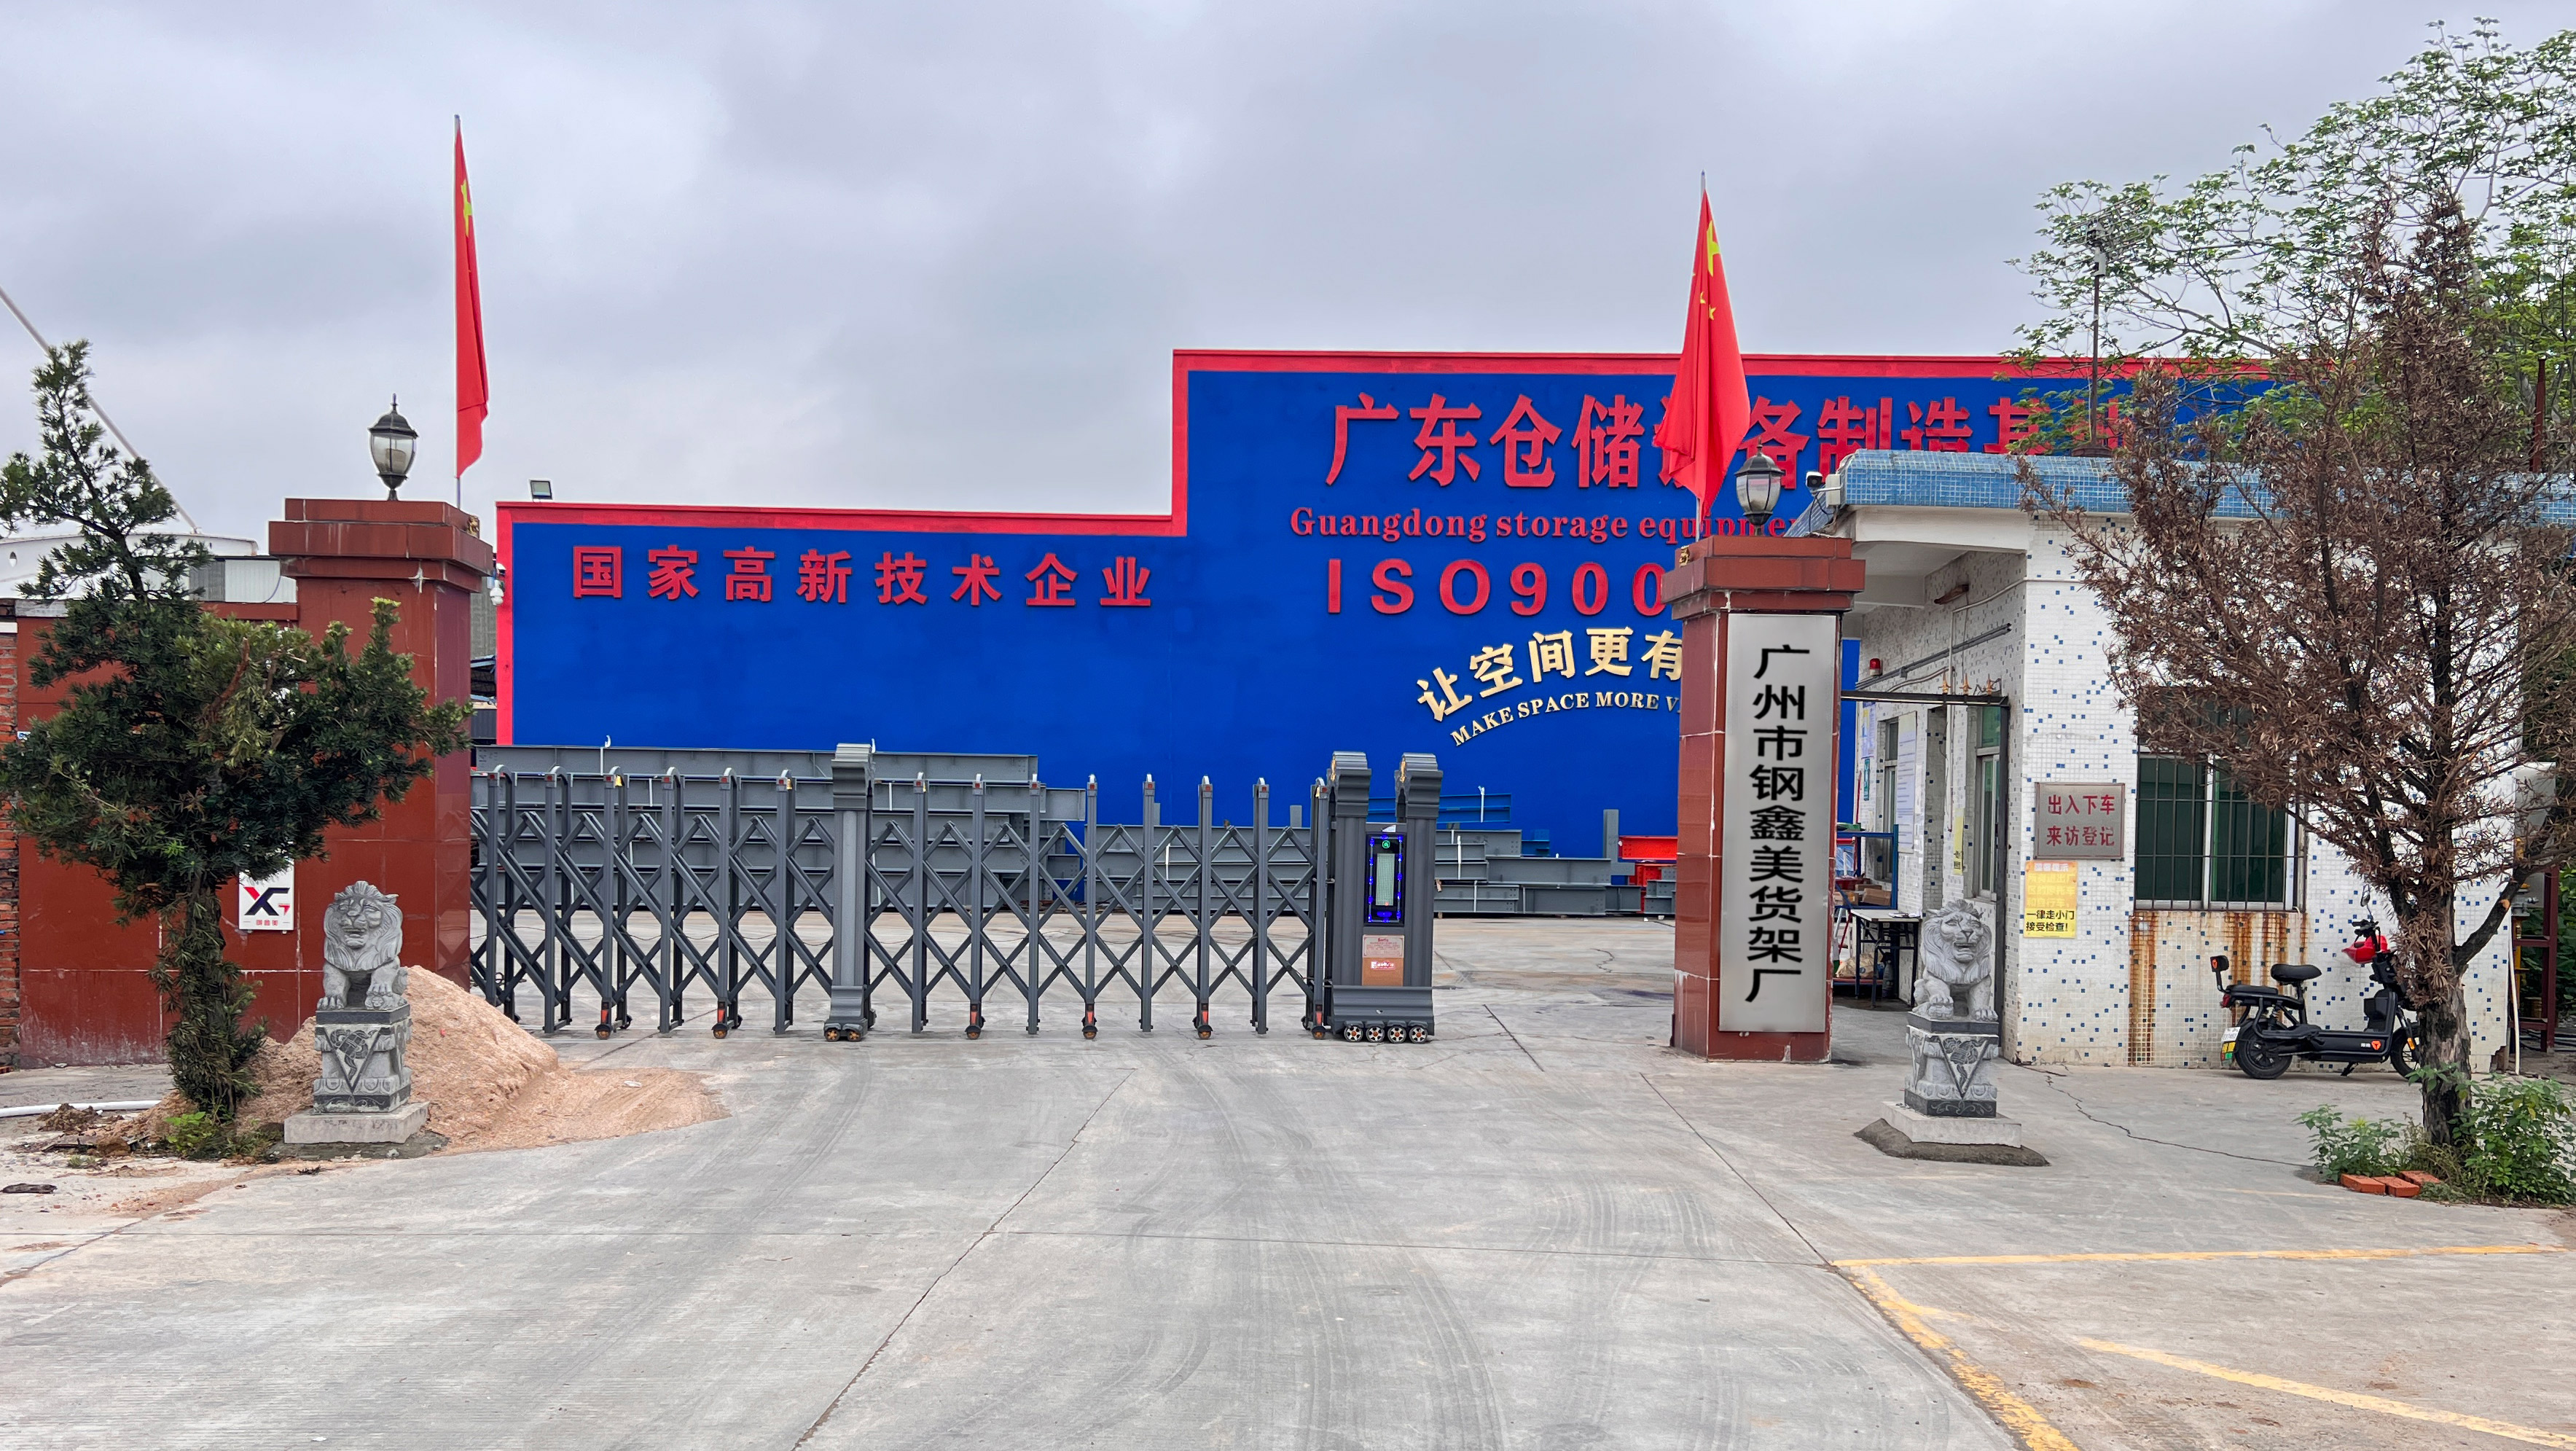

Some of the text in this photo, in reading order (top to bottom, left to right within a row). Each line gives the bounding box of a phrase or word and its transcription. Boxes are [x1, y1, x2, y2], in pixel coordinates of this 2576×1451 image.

[1326, 391, 2137, 490] 广东仓储备制造基
[1291, 507, 1488, 543] Guangdong
[1495, 511, 1627, 543] storage
[572, 545, 1152, 608] 国家高新技术企业
[1417, 626, 1683, 722] 让空间更有
[1449, 706, 1514, 746] MAKE
[1517, 692, 1589, 719] SPACE
[1594, 692, 1659, 710] MORE
[1745, 644, 1810, 1003] 广州市钢鑫美货架厂
[2048, 794, 2115, 816] 出入下车
[2046, 825, 2115, 847] 来访登记
[2026, 910, 2075, 920] 一律走小门
